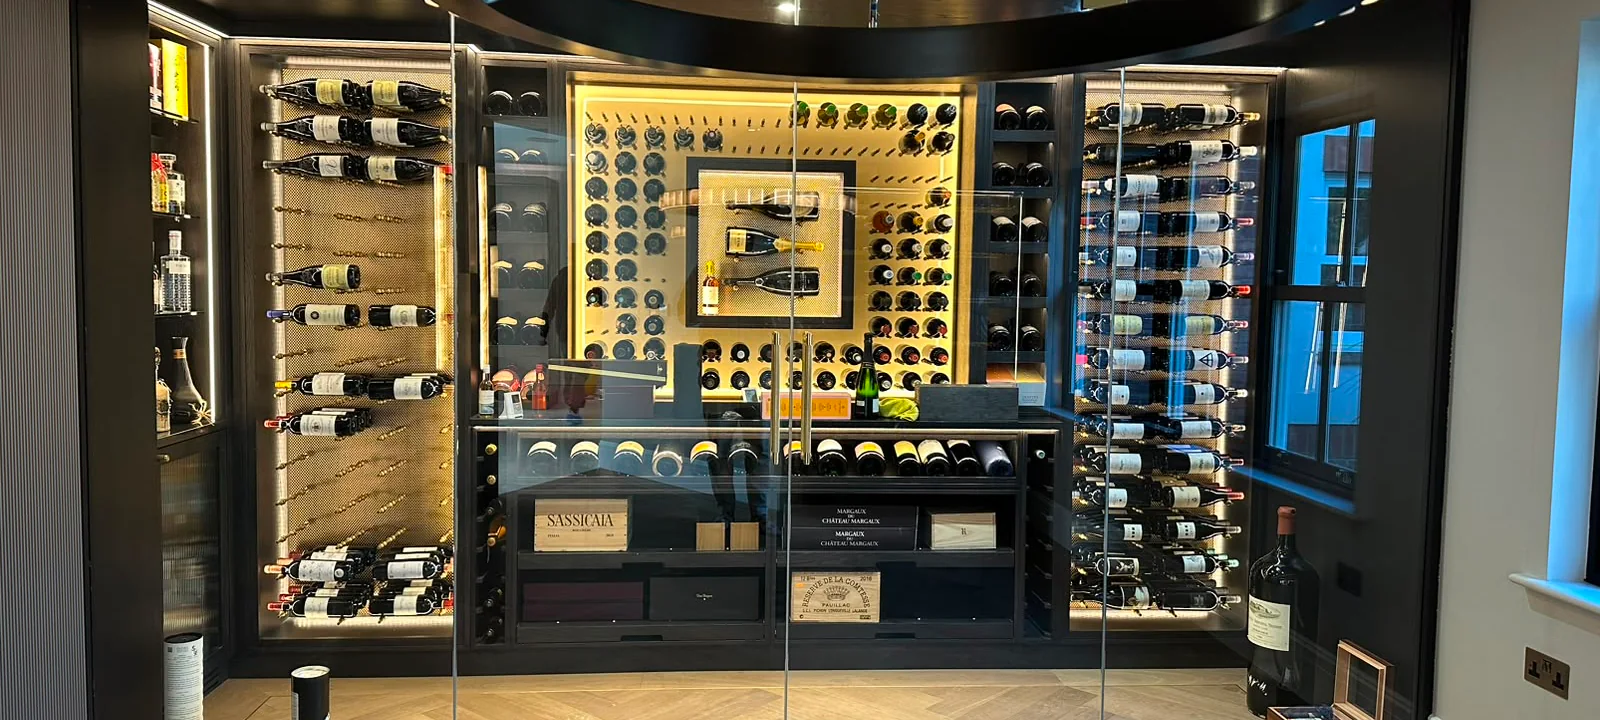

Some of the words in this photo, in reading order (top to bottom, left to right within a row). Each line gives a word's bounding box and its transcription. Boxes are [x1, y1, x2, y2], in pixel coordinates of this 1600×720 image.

[547, 513, 613, 527] SASSICAIA
[802, 580, 824, 607] RESERVE
[823, 576, 832, 584] DE
[845, 578, 871, 608] COMTESSE
